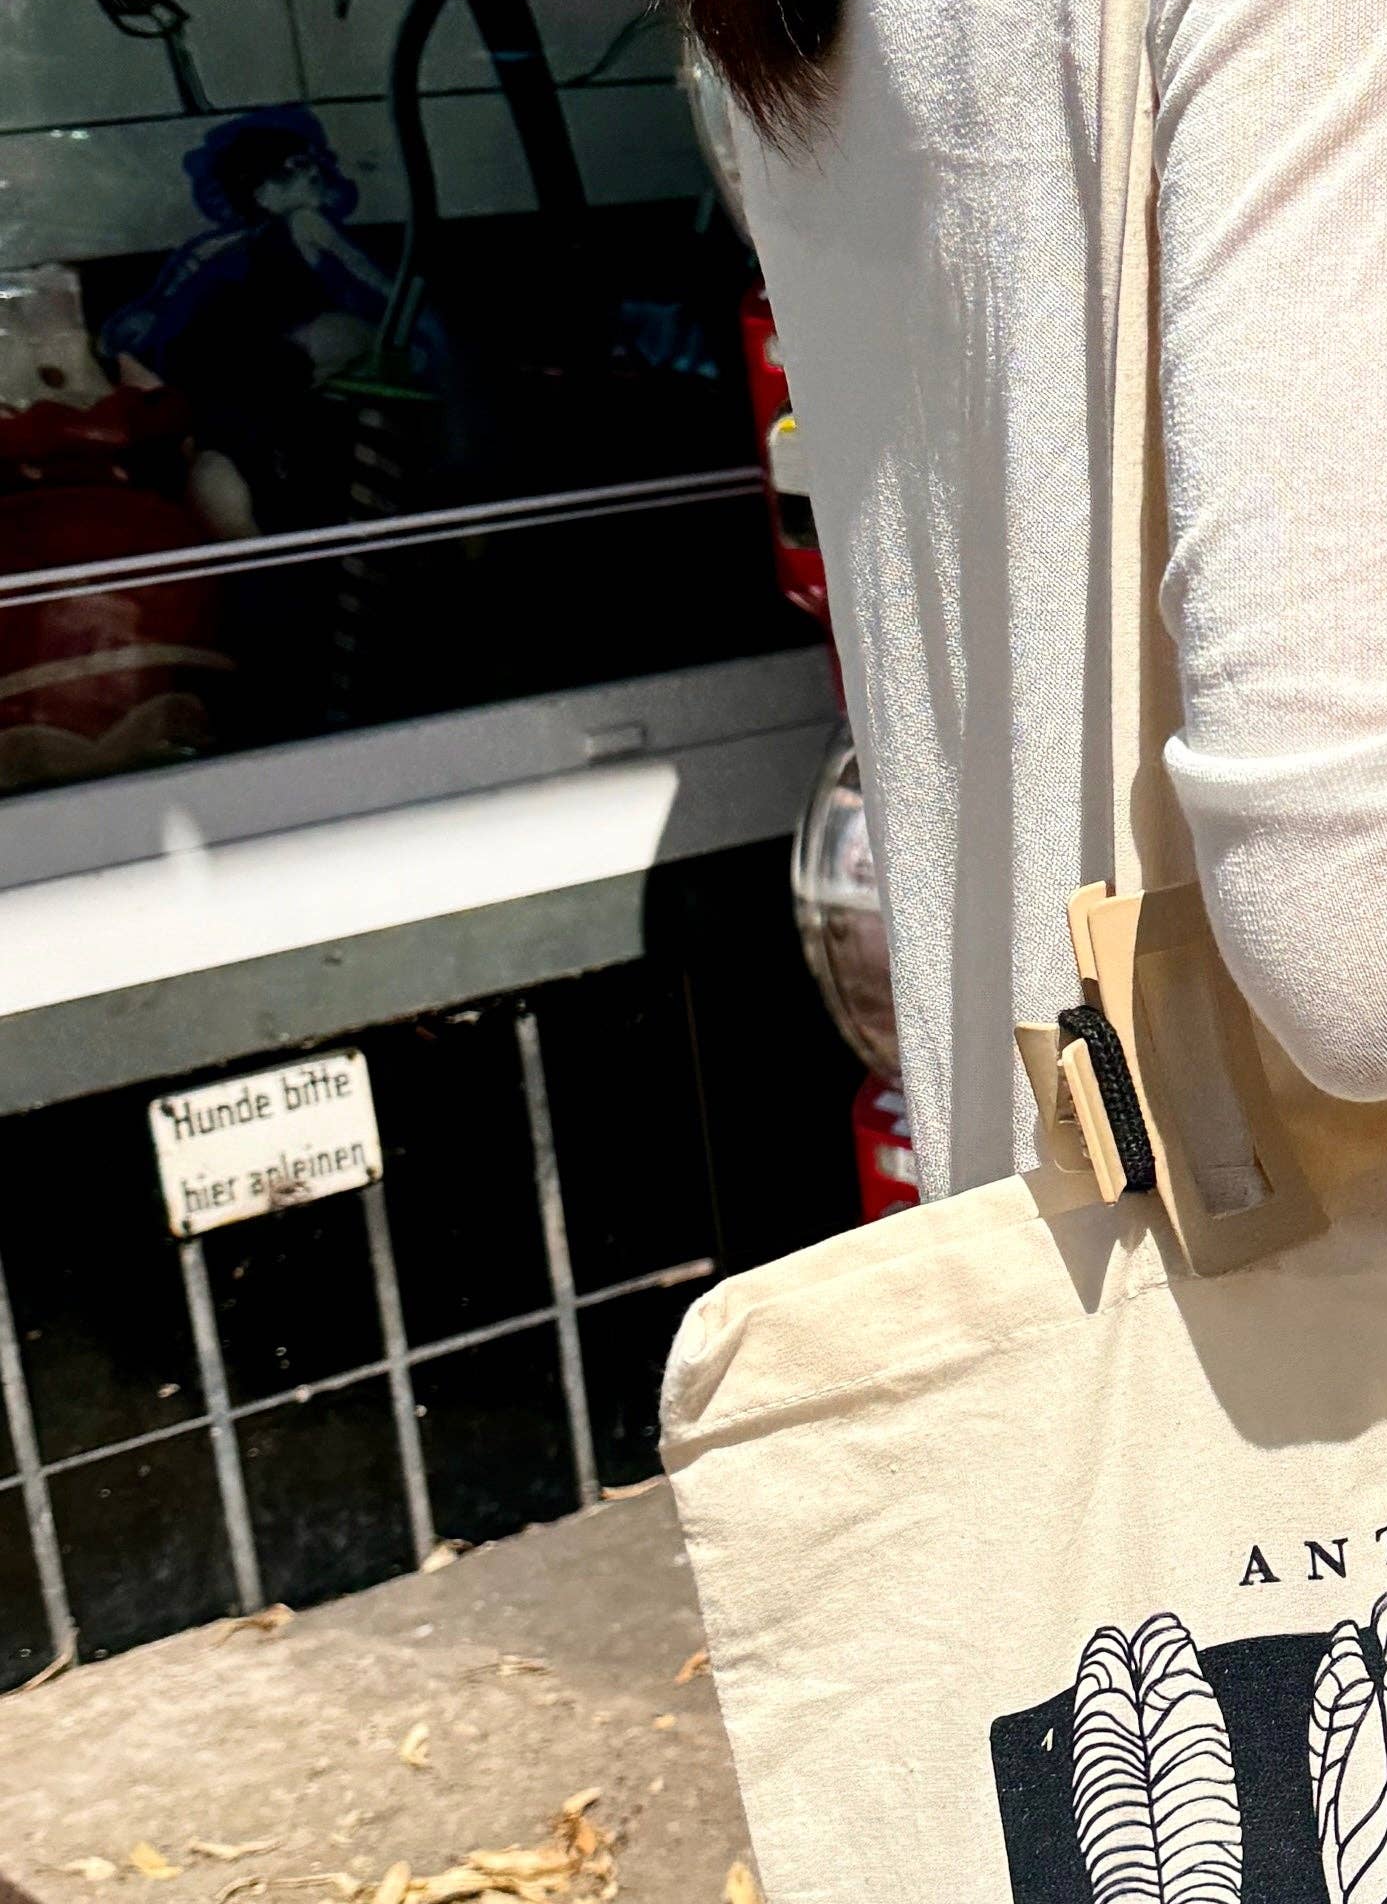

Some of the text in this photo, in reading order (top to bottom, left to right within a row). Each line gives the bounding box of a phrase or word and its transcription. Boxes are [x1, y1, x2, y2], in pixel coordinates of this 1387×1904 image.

[172, 1064, 352, 1141] Hunde bitte
[181, 1142, 367, 1213] hier anleinen
